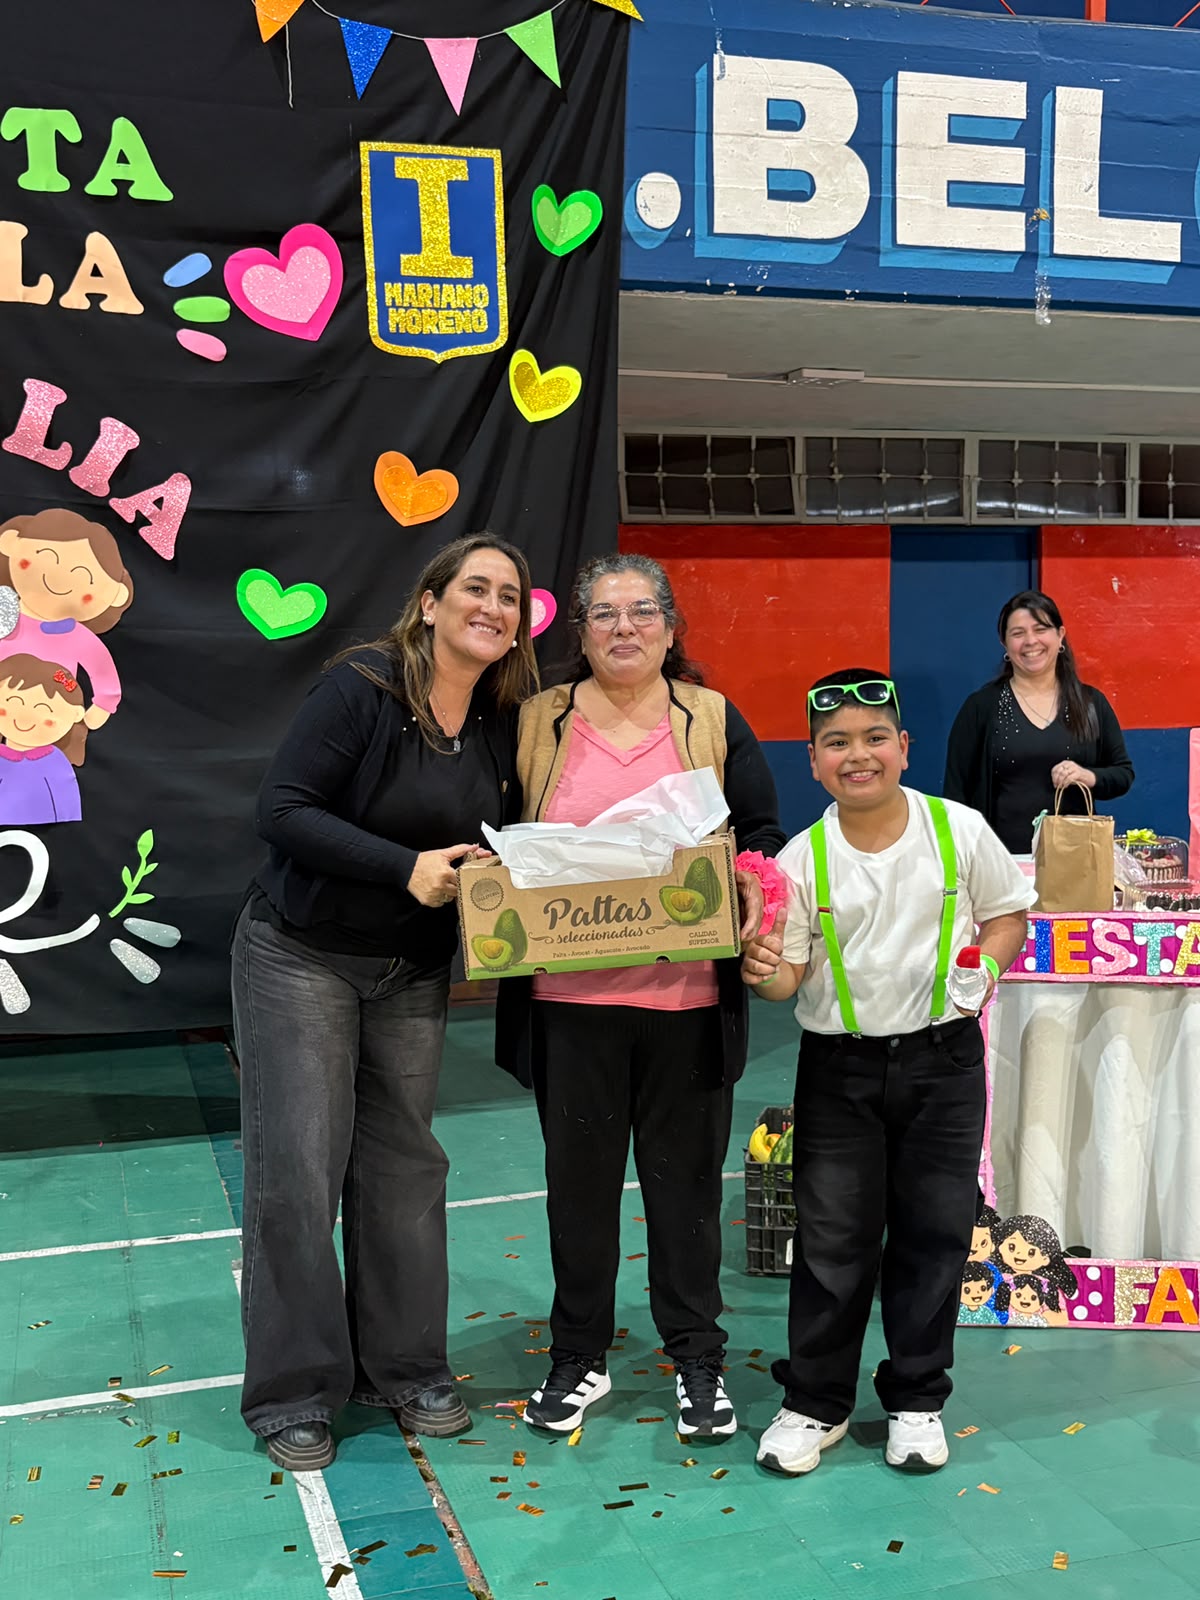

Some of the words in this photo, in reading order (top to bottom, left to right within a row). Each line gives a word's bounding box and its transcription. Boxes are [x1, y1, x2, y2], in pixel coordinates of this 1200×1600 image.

[394, 156, 474, 279] I
[384, 282, 489, 309] MARIANO
[388, 308, 488, 335] MORENO
[543, 894, 652, 930] Paltas
[557, 926, 643, 945] seleccionadas
[688, 930, 718, 938] CALIDAD
[688, 937, 720, 946] SUPERIOR
[1021, 919, 1200, 976] IESTA
